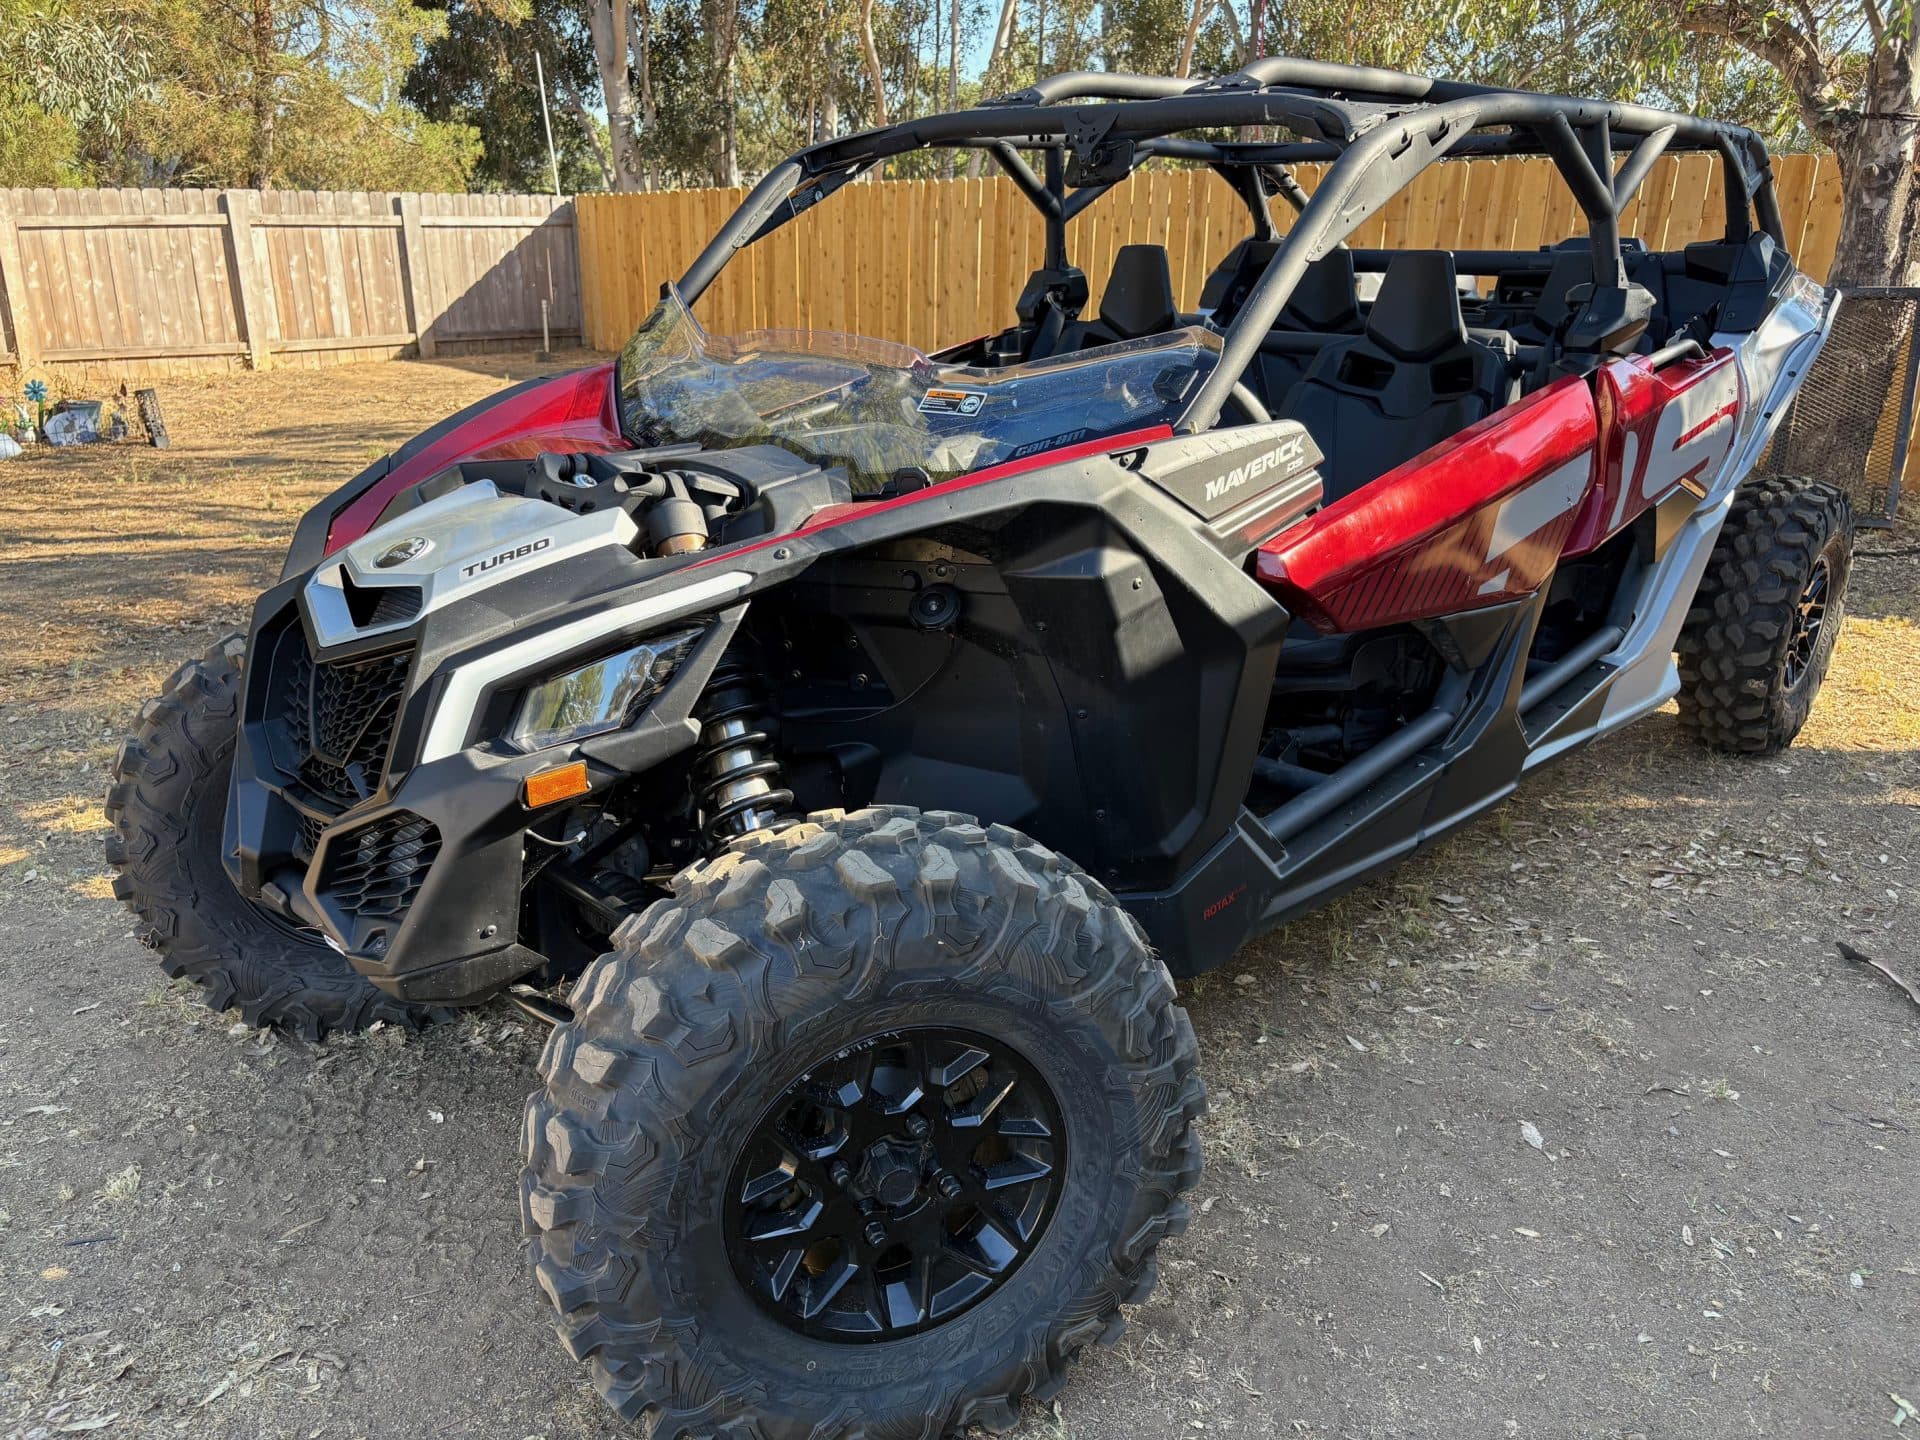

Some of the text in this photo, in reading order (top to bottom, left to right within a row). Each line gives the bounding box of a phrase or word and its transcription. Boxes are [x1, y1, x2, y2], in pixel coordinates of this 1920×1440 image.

[1205, 434, 1304, 503] MAVERICK
[462, 538, 550, 577] TURBO
[1203, 892, 1236, 920] ROTAX
